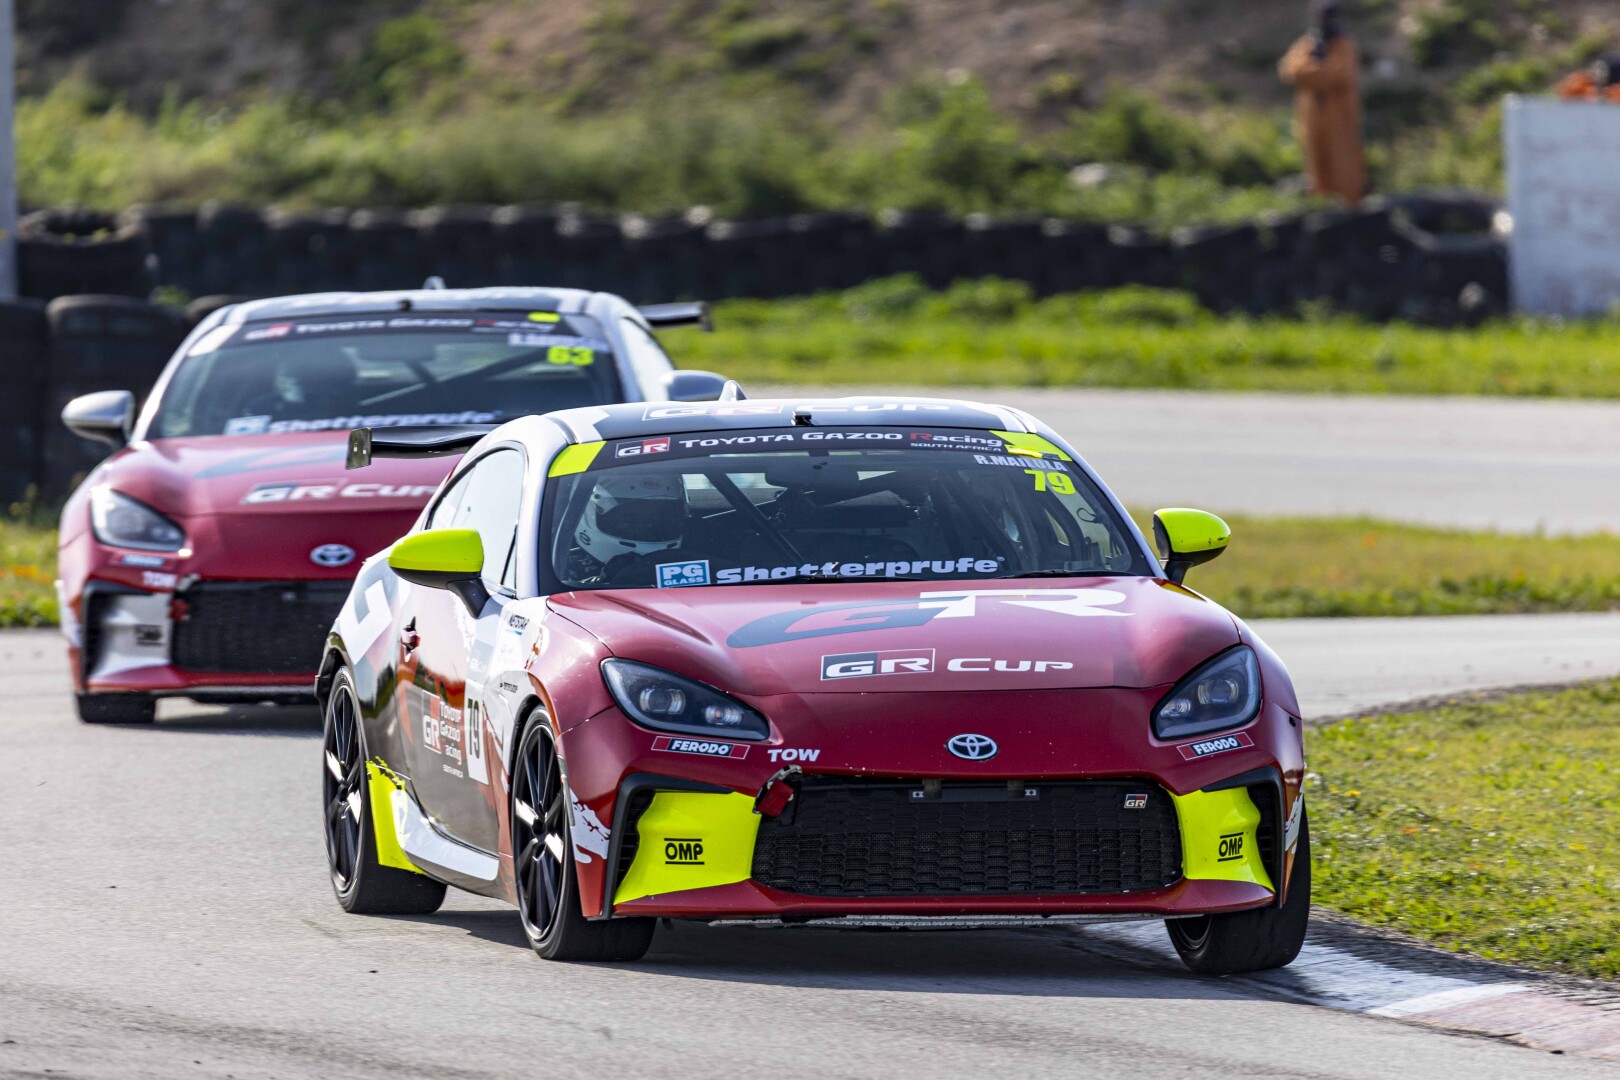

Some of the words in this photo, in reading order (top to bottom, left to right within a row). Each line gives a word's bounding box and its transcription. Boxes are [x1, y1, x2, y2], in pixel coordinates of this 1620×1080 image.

[547, 346, 595, 366] 63
[646, 404, 783, 418] GR
[616, 442, 668, 457] GR
[679, 434, 794, 448] TOYOTA
[802, 431, 903, 441] GAZOO
[910, 432, 1002, 447] Racing
[973, 454, 1068, 472] R.MAILULA
[1024, 469, 1076, 495] 79
[242, 484, 336, 504] GR
[662, 565, 704, 580] PG
[664, 577, 704, 586] GLASS
[826, 656, 930, 678] GR
[946, 657, 1074, 672] CUP
[423, 714, 441, 750] GR
[467, 697, 480, 759] 79
[671, 740, 729, 754] FERODO
[767, 748, 821, 762] TOW
[1192, 737, 1238, 755] FERODO
[665, 842, 704, 860] OMP
[1218, 836, 1243, 857] OMP
